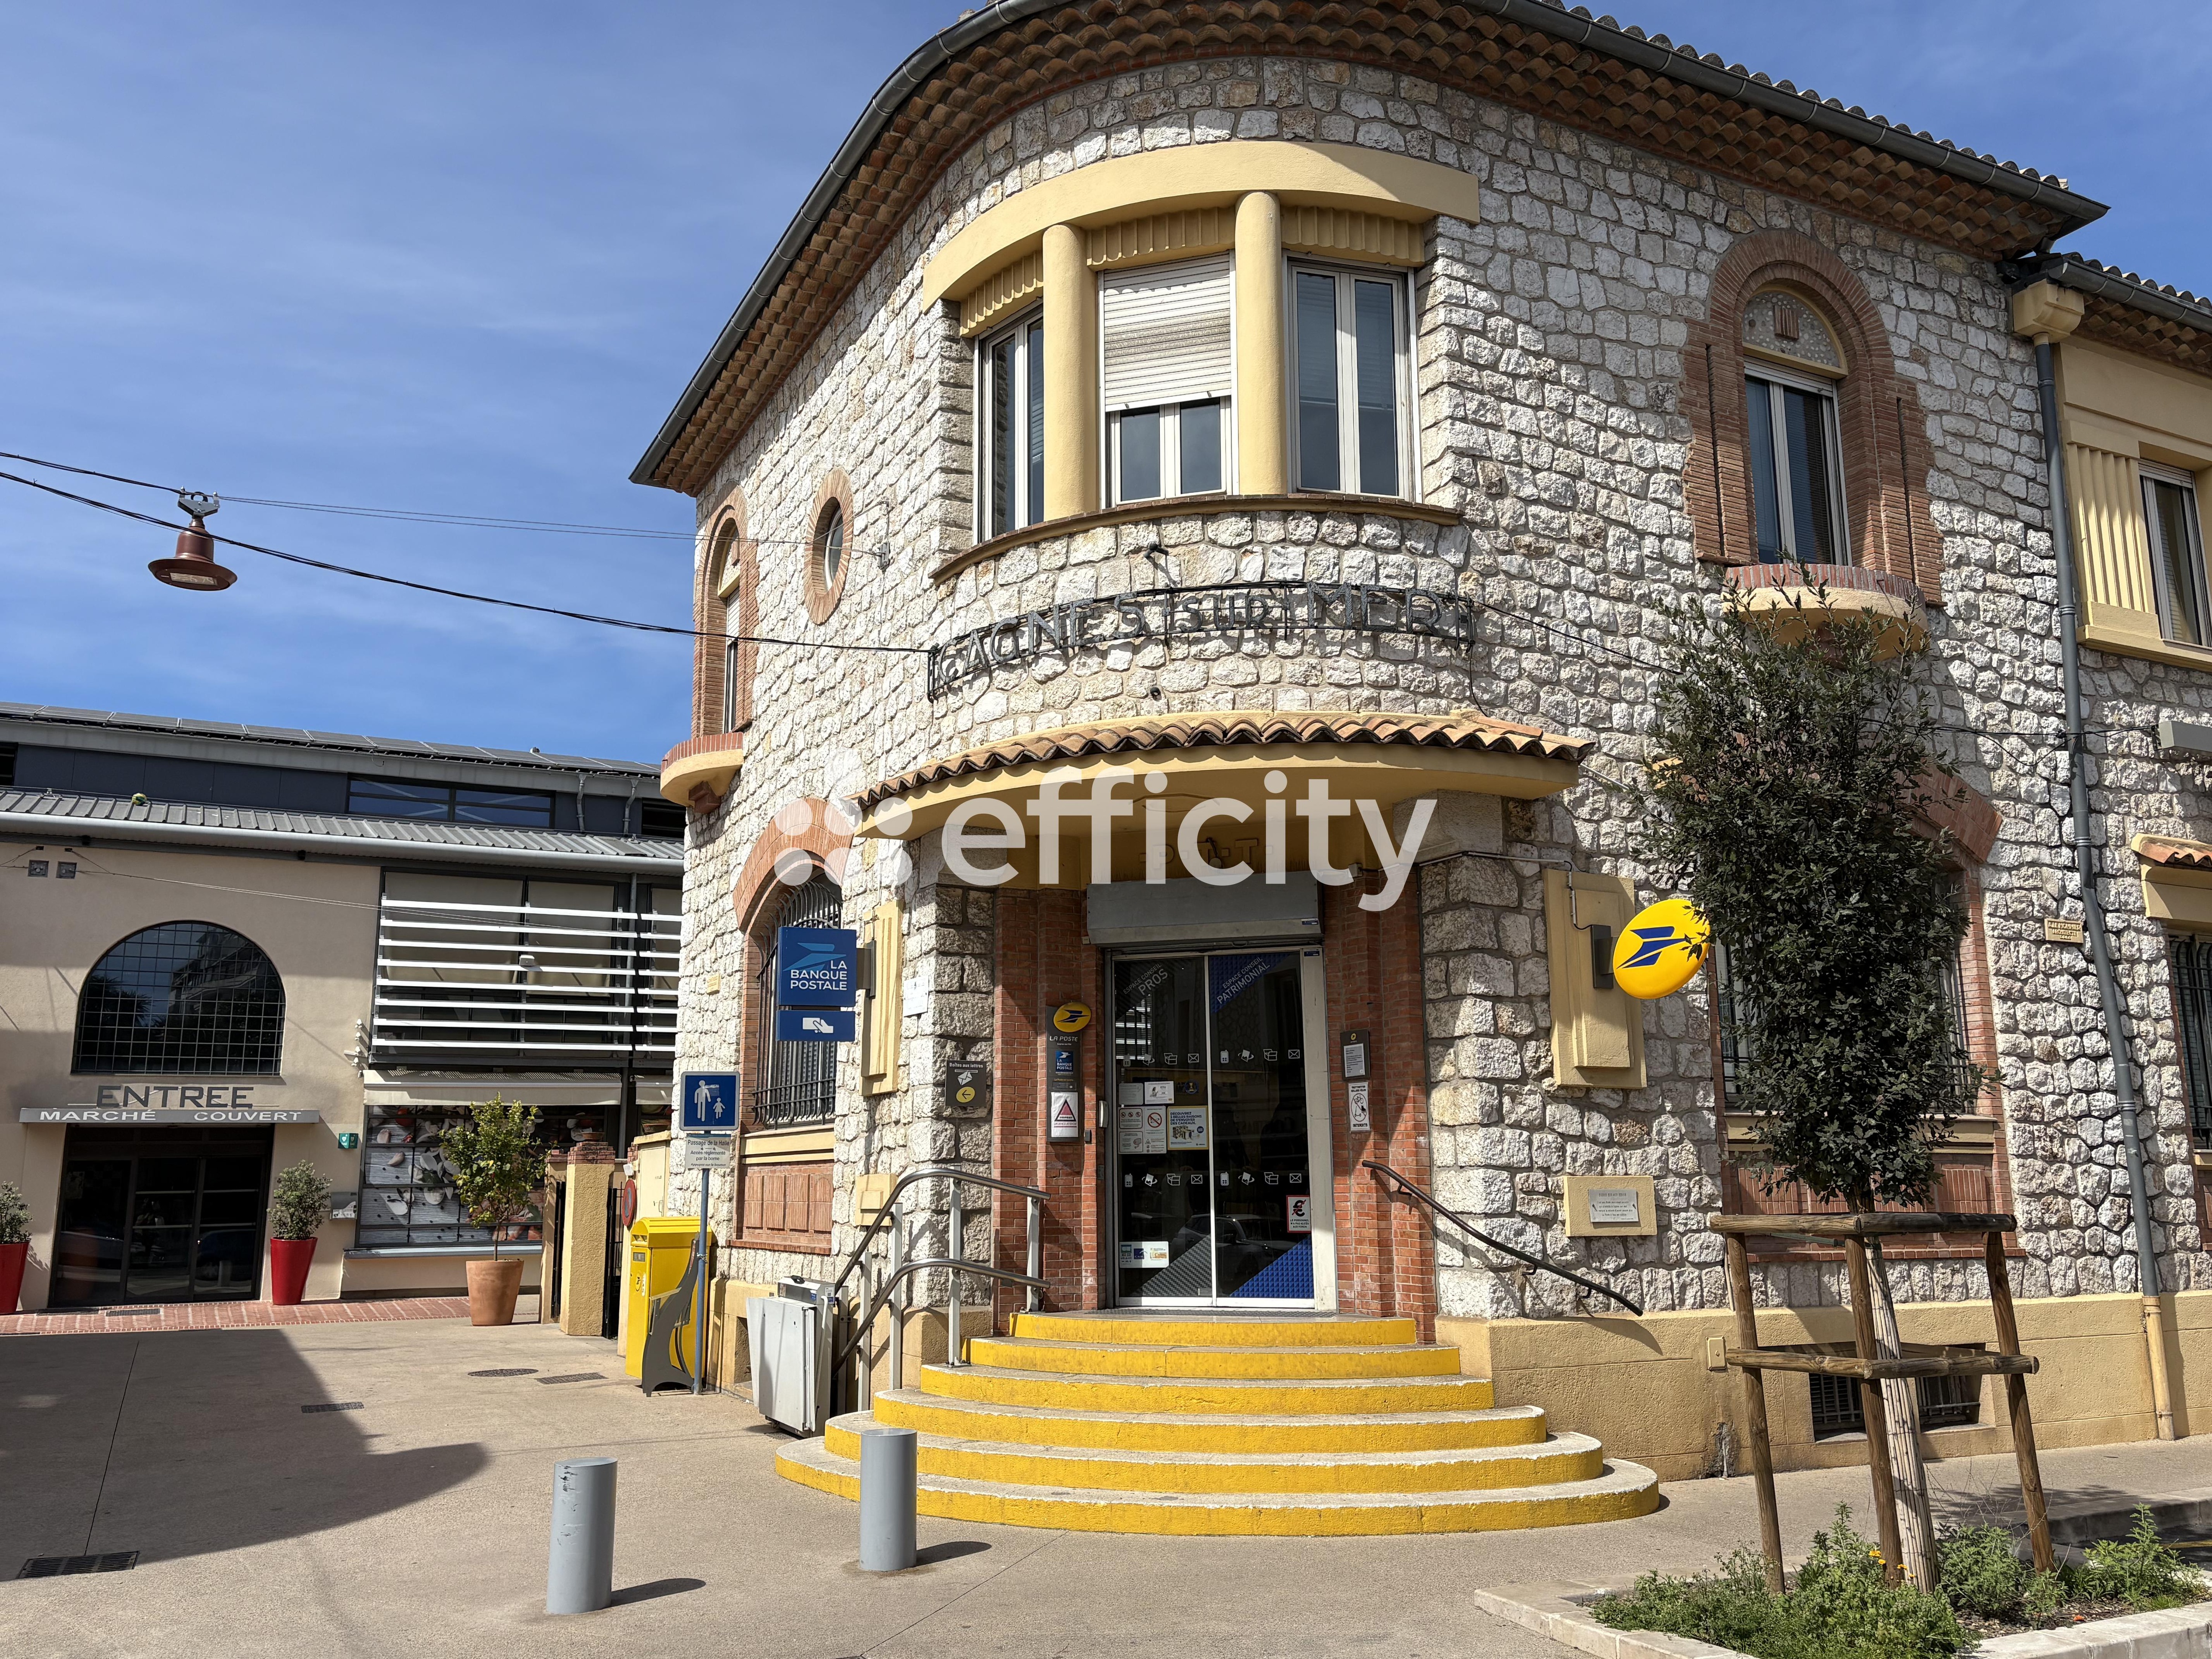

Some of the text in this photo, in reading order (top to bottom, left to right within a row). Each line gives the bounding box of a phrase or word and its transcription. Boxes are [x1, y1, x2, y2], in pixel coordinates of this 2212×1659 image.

[938, 581, 1443, 683] CAGNES SUR MER
[790, 970, 847, 980] BANQUE
[831, 960, 847, 969] LA
[1222, 957, 1263, 989] ESPACE CONSEIL
[790, 980, 847, 991] POSTALE
[1123, 963, 1162, 994] ESPACE CONSEIL
[1138, 968, 1168, 996] PROS
[1216, 962, 1270, 1004] PATRIMONIAL
[97, 1085, 254, 1108] ENTREE
[40, 1109, 302, 1121] MARCHÉ COUVERT
